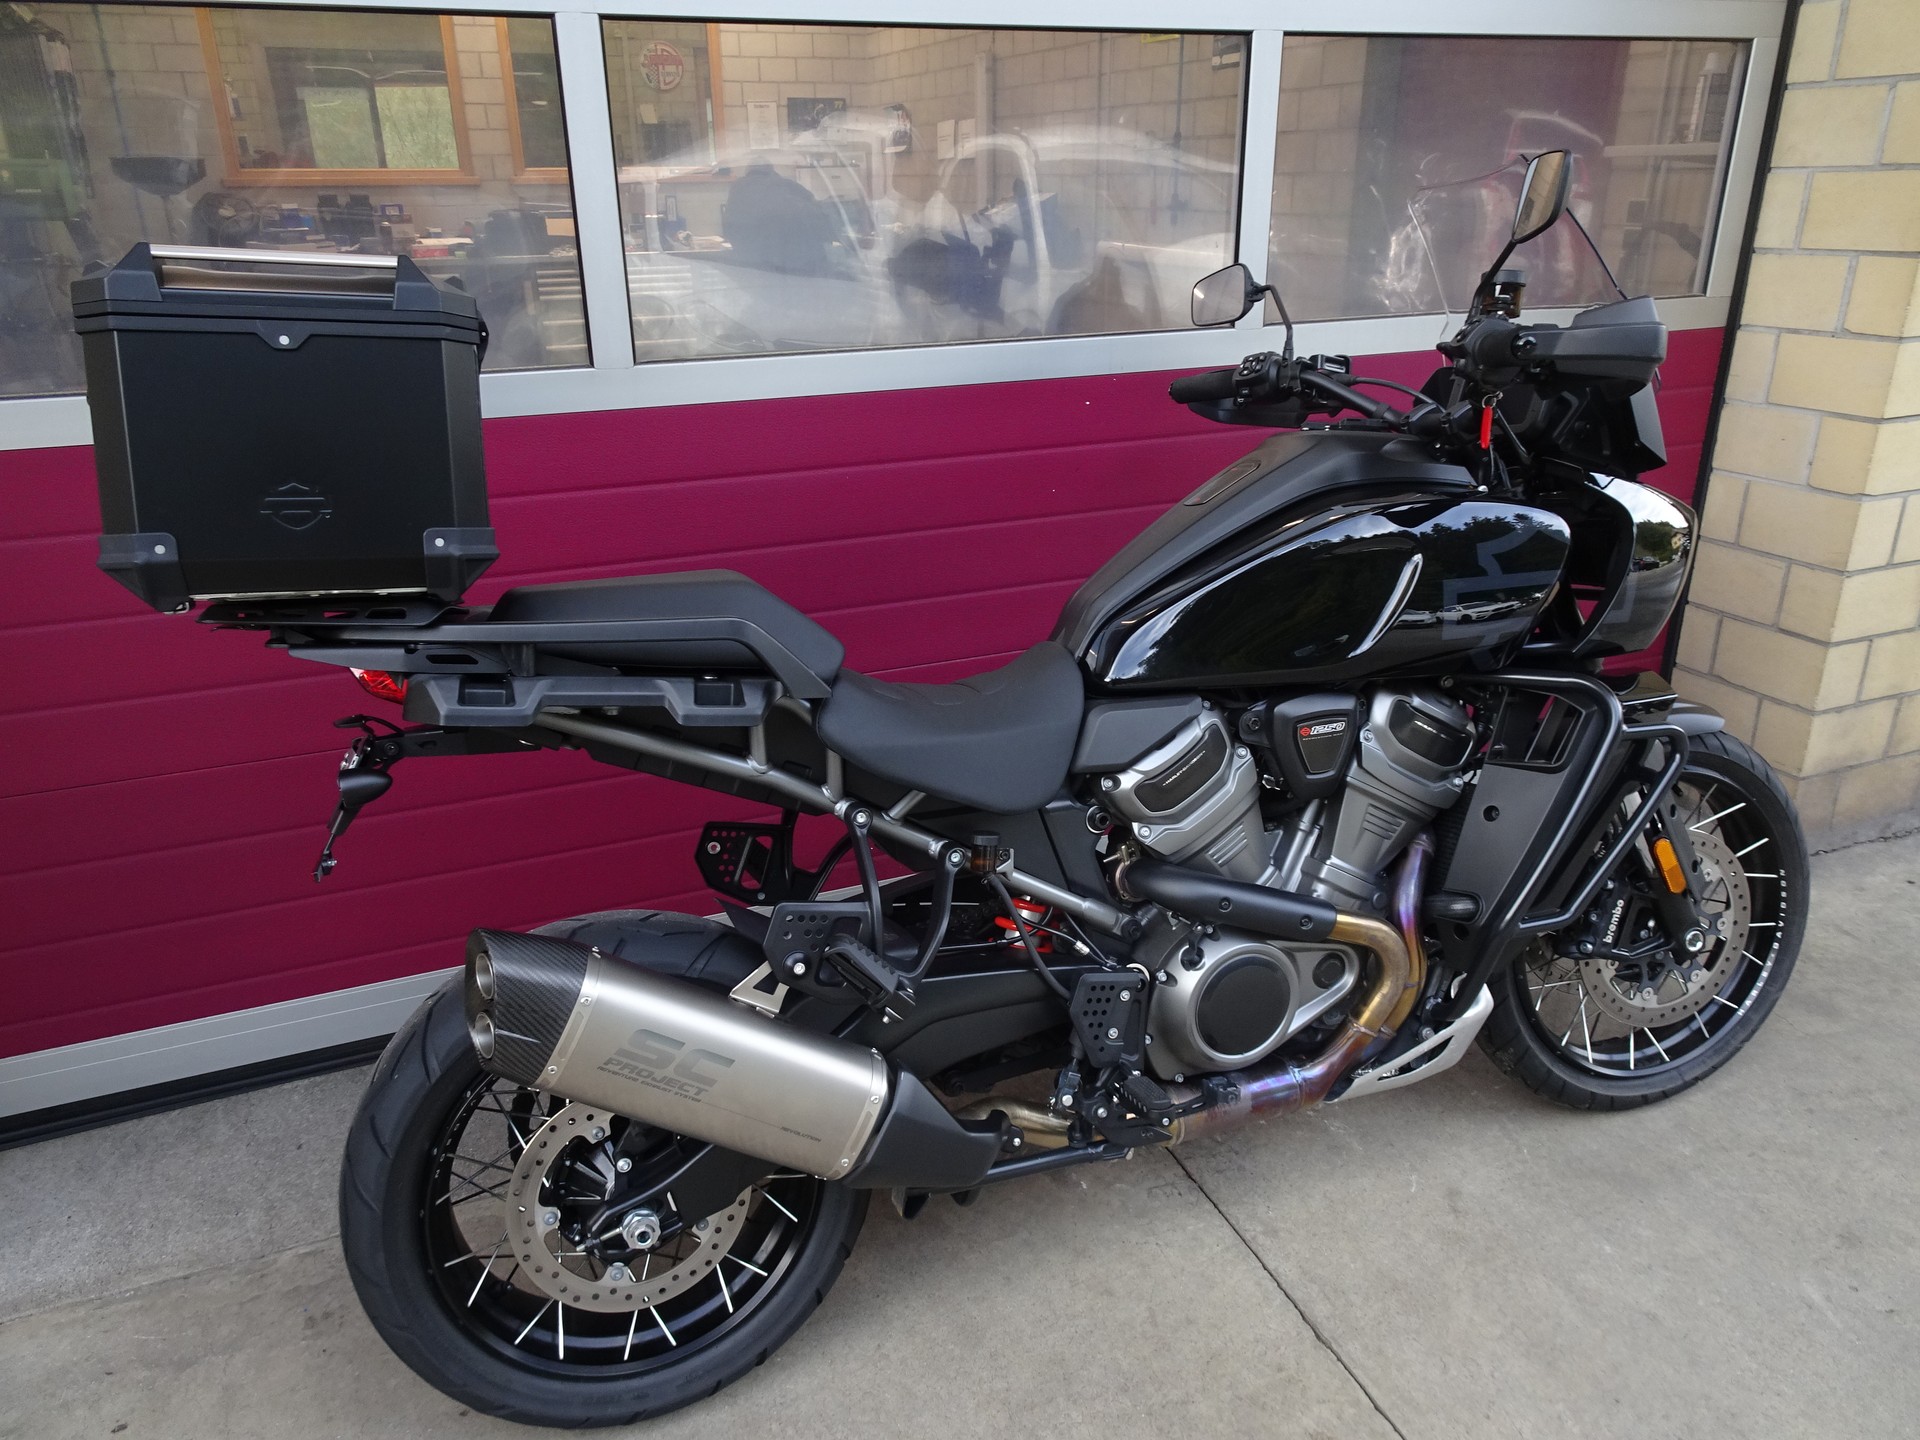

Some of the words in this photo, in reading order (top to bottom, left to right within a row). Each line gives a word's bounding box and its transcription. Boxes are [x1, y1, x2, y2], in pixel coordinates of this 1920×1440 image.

[1310, 722, 1345, 735] 1250
[1603, 900, 1624, 943] brembo
[603, 1057, 709, 1096] PROJECT
[614, 1029, 735, 1088] SC
